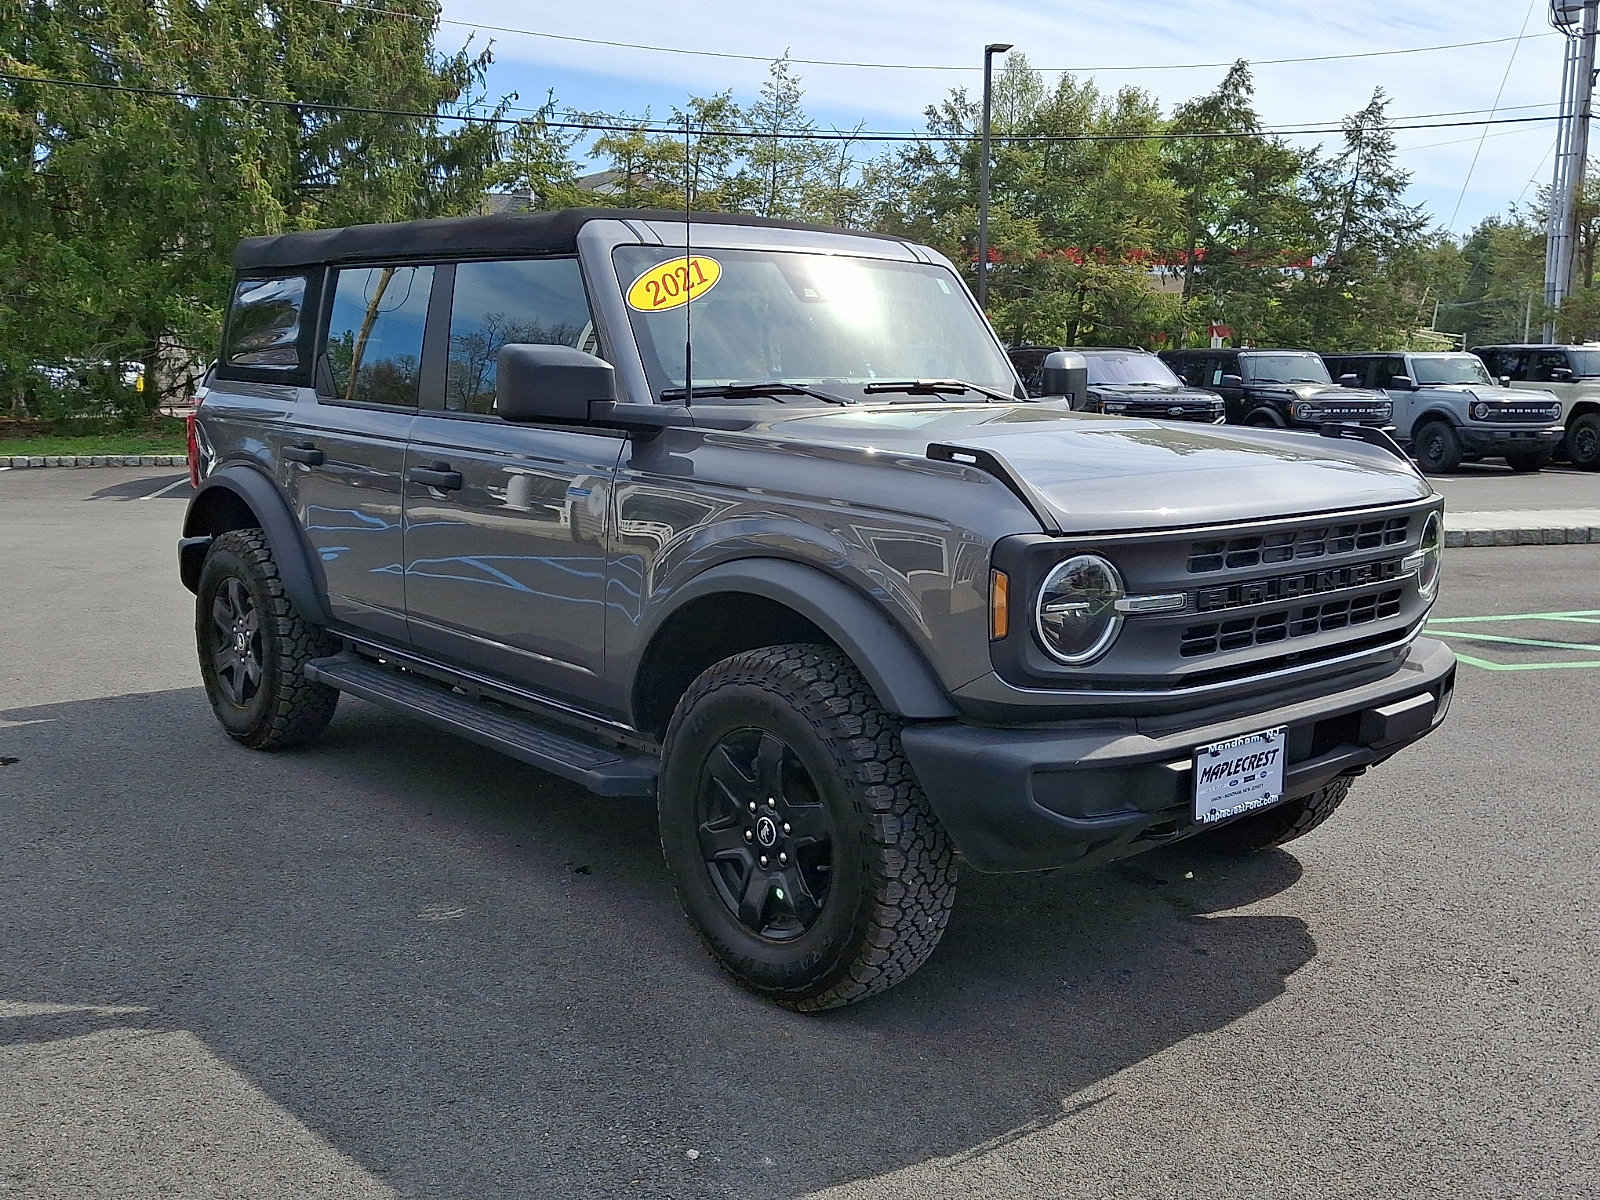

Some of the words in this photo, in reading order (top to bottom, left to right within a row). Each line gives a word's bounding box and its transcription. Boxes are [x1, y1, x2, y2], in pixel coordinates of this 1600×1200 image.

[645, 260, 708, 306] 2021
[1266, 729, 1279, 738] NJ
[1200, 748, 1279, 784] MAPLECREST
[1202, 794, 1280, 823] MaplecrestFord.com
